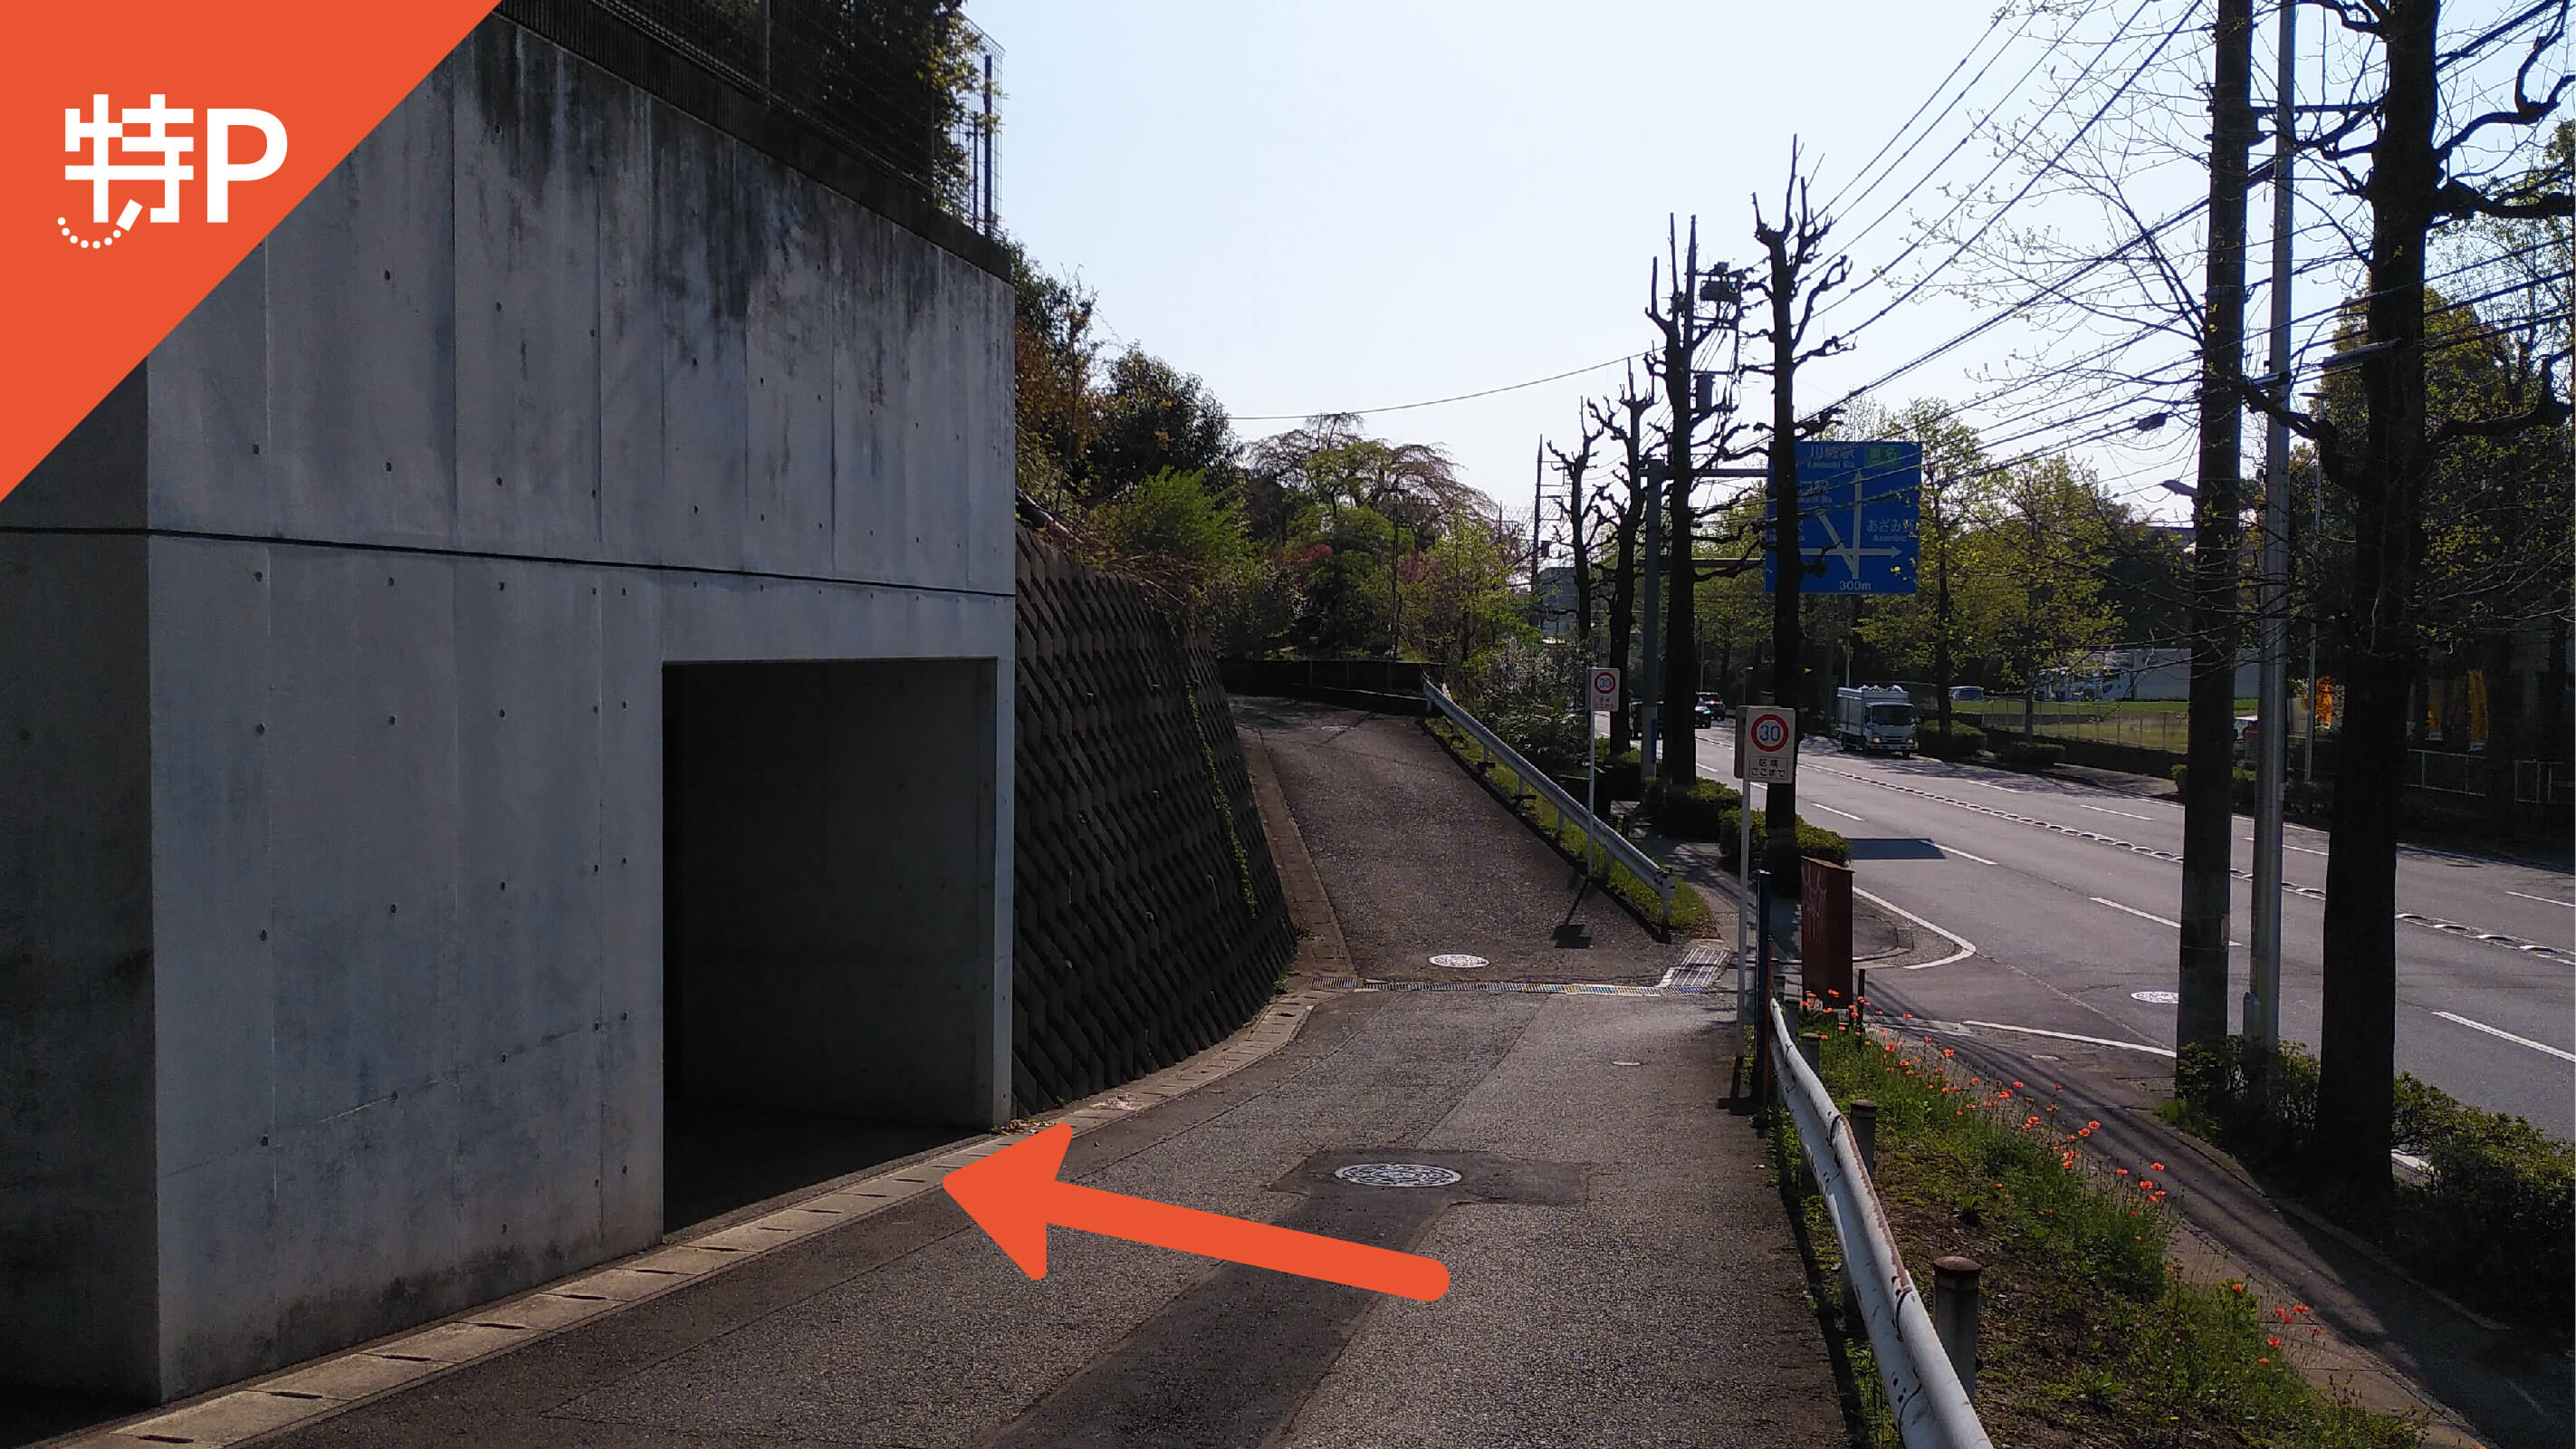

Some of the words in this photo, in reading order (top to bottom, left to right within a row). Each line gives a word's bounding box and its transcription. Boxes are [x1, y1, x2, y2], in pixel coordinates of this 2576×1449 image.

[1839, 581, 1872, 591] 300m
[1599, 677, 1612, 688] 30
[1759, 725, 1781, 742] 30
[1751, 768, 1786, 777] ここまで
